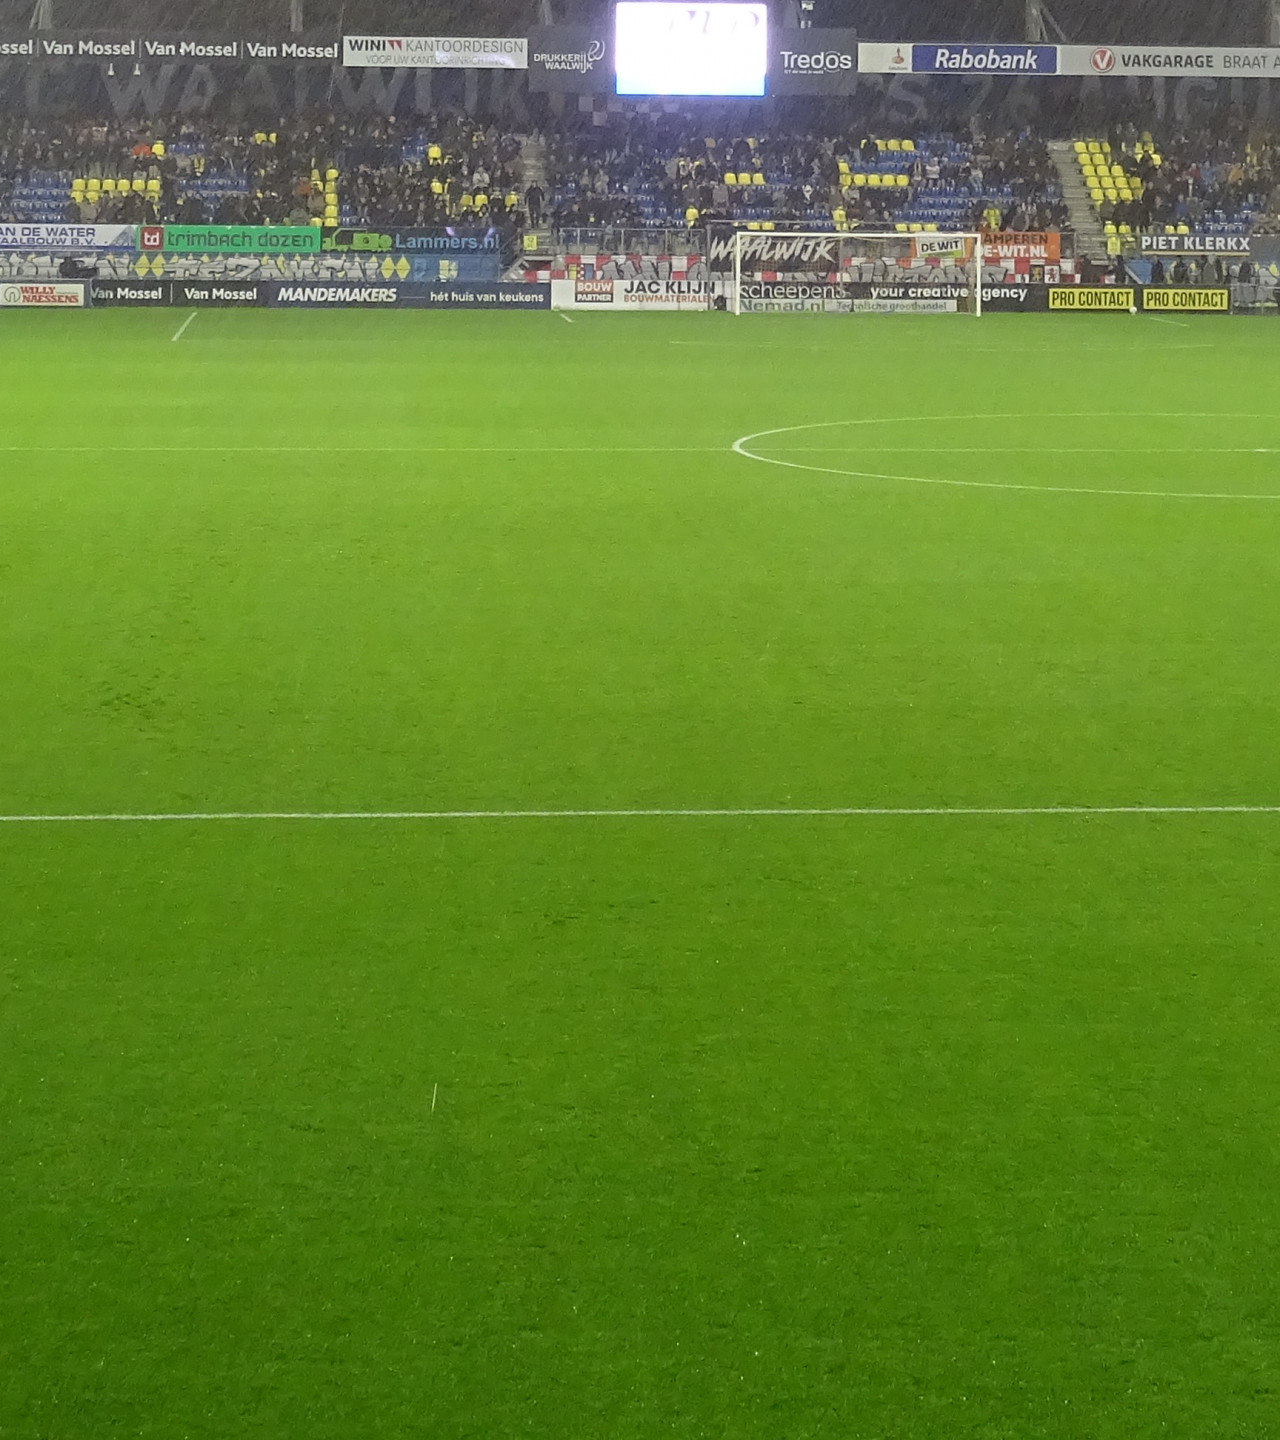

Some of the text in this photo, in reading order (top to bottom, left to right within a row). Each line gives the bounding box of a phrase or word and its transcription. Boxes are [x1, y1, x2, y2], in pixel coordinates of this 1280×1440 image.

[43, 40, 135, 55] Van Mossel
[145, 41, 237, 56] Van Mossel
[247, 42, 338, 58] Van Mossel
[349, 39, 524, 53] WINI KANTOORDESIGN
[935, 48, 1038, 70] Rabobank
[1122, 54, 1214, 68] VAKGARAGE
[1223, 55, 1268, 69] BRAAT
[21, 227, 40, 237] DE
[46, 227, 96, 237] WATER
[71, 237, 96, 246] B.V.
[395, 233, 500, 249] Lammers.nl
[921, 239, 960, 253] DE WIT
[983, 235, 1048, 245] AMPEREN
[1141, 236, 1251, 251] PIET KLERKX
[20, 286, 56, 294] WILLY
[93, 288, 162, 300] Van Mossel
[184, 288, 257, 300] Van Mossel
[577, 282, 612, 292] BOUW
[624, 281, 715, 294] JAC KLIJN
[871, 286, 905, 300] your
[908, 284, 969, 298] creative
[22, 295, 79, 304] NAESSENS
[278, 287, 544, 303] MANDEMAKERS hét huis van keukens
[577, 293, 612, 302] PARTNER
[624, 295, 716, 303] BOUWMATERIALEN
[1052, 291, 1131, 307] PRO CONTACT
[1146, 292, 1226, 307] PRO CONTACT
